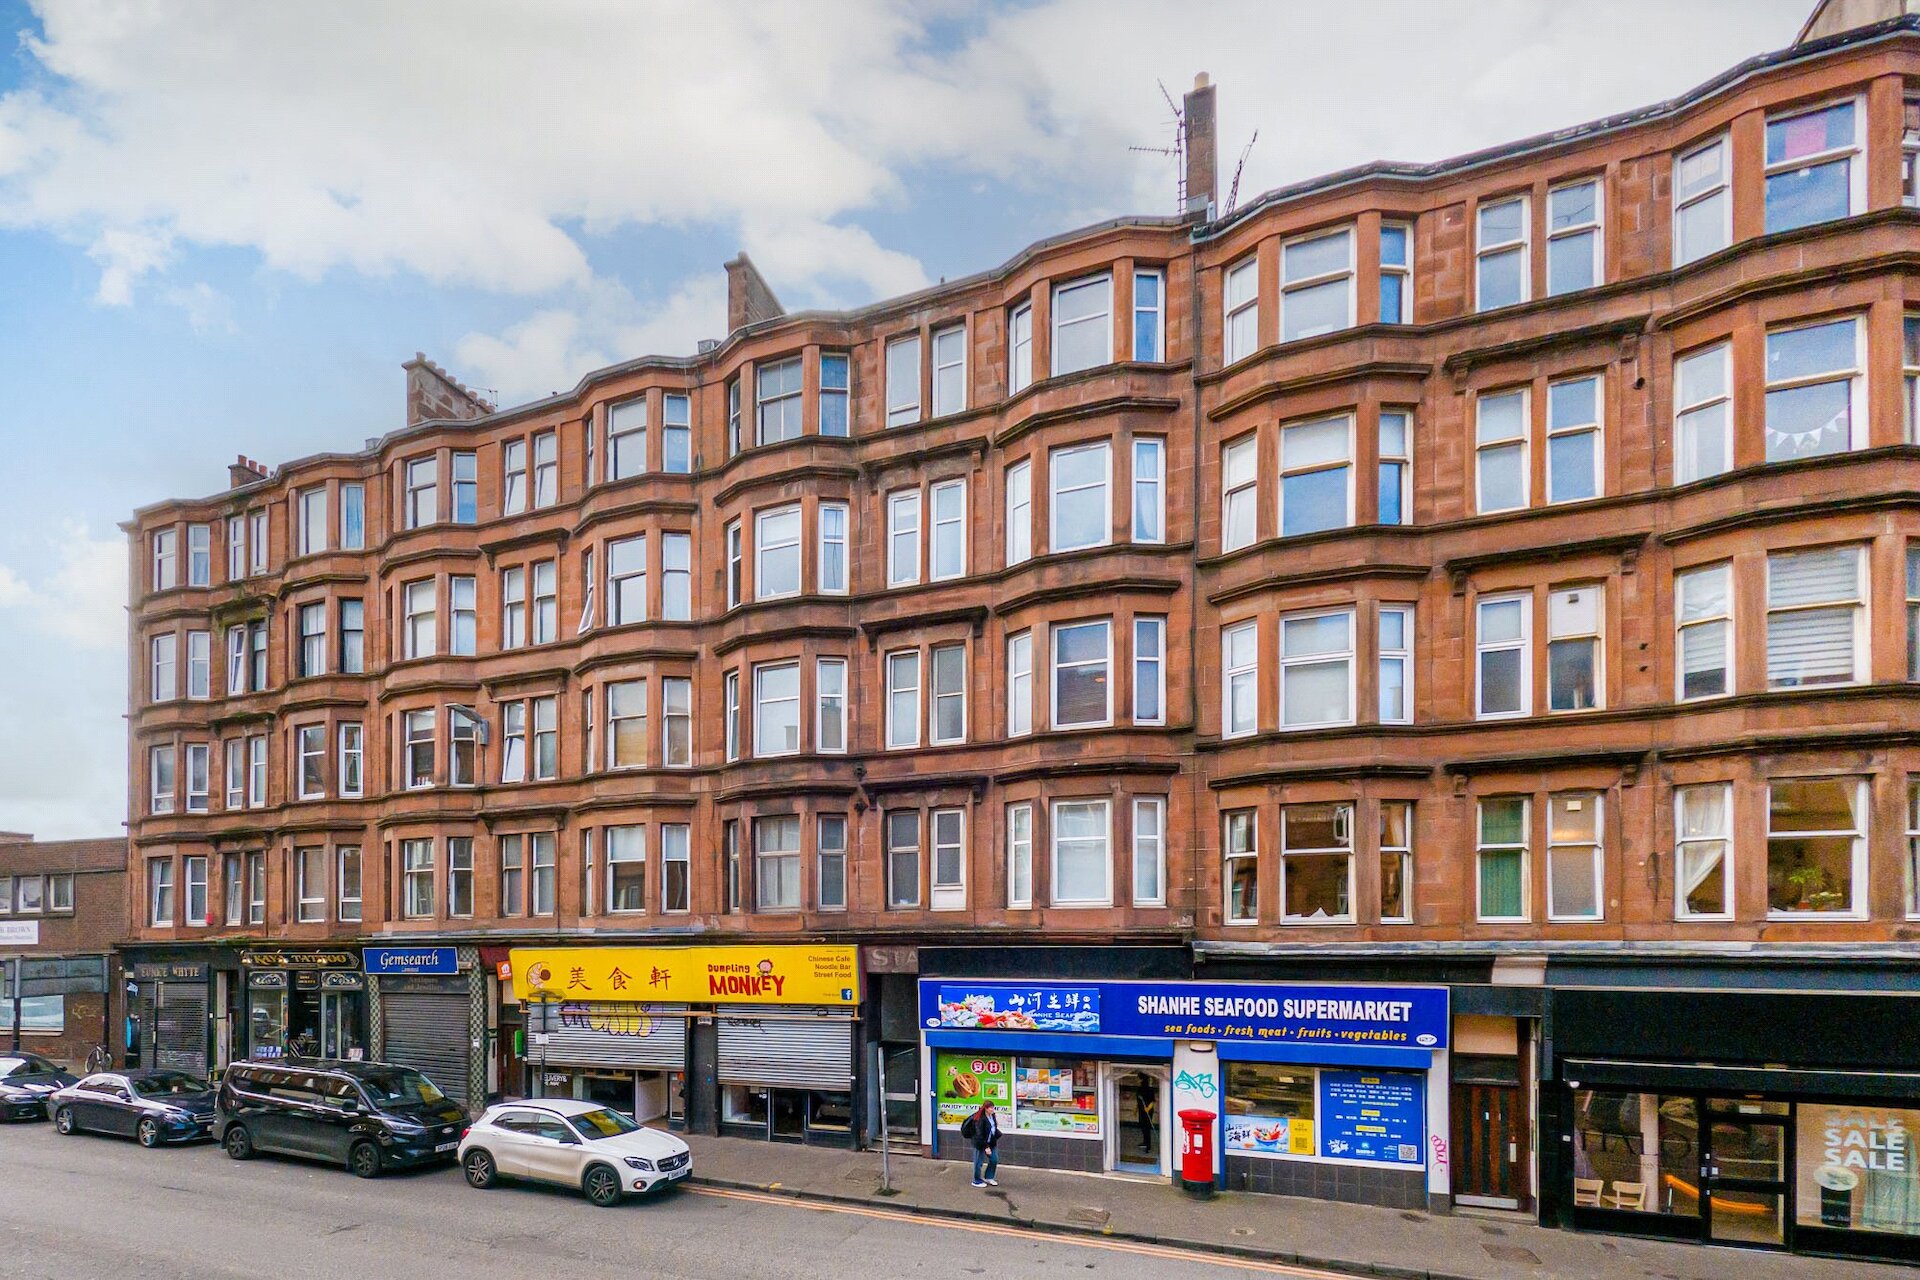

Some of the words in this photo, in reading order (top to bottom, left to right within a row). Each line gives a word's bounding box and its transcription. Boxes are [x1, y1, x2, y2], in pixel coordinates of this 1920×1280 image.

[380, 949, 439, 970] Gemsearch
[567, 966, 671, 991] 美食軒
[709, 975, 785, 996] MONKEY
[1138, 995, 1200, 1016] SHANHE
[1204, 997, 1279, 1018] SEAFOOD
[1283, 998, 1413, 1022] SUPERMARKET
[1164, 1024, 1182, 1033] sea
[1185, 1023, 1216, 1035] foods
[1223, 1024, 1254, 1038] fresh
[1258, 1026, 1287, 1038] meat
[1297, 1027, 1332, 1039] fruits
[1341, 1029, 1407, 1041] vegetables
[1824, 1128, 1905, 1150] SALE
[1824, 1148, 1905, 1171] SALE
